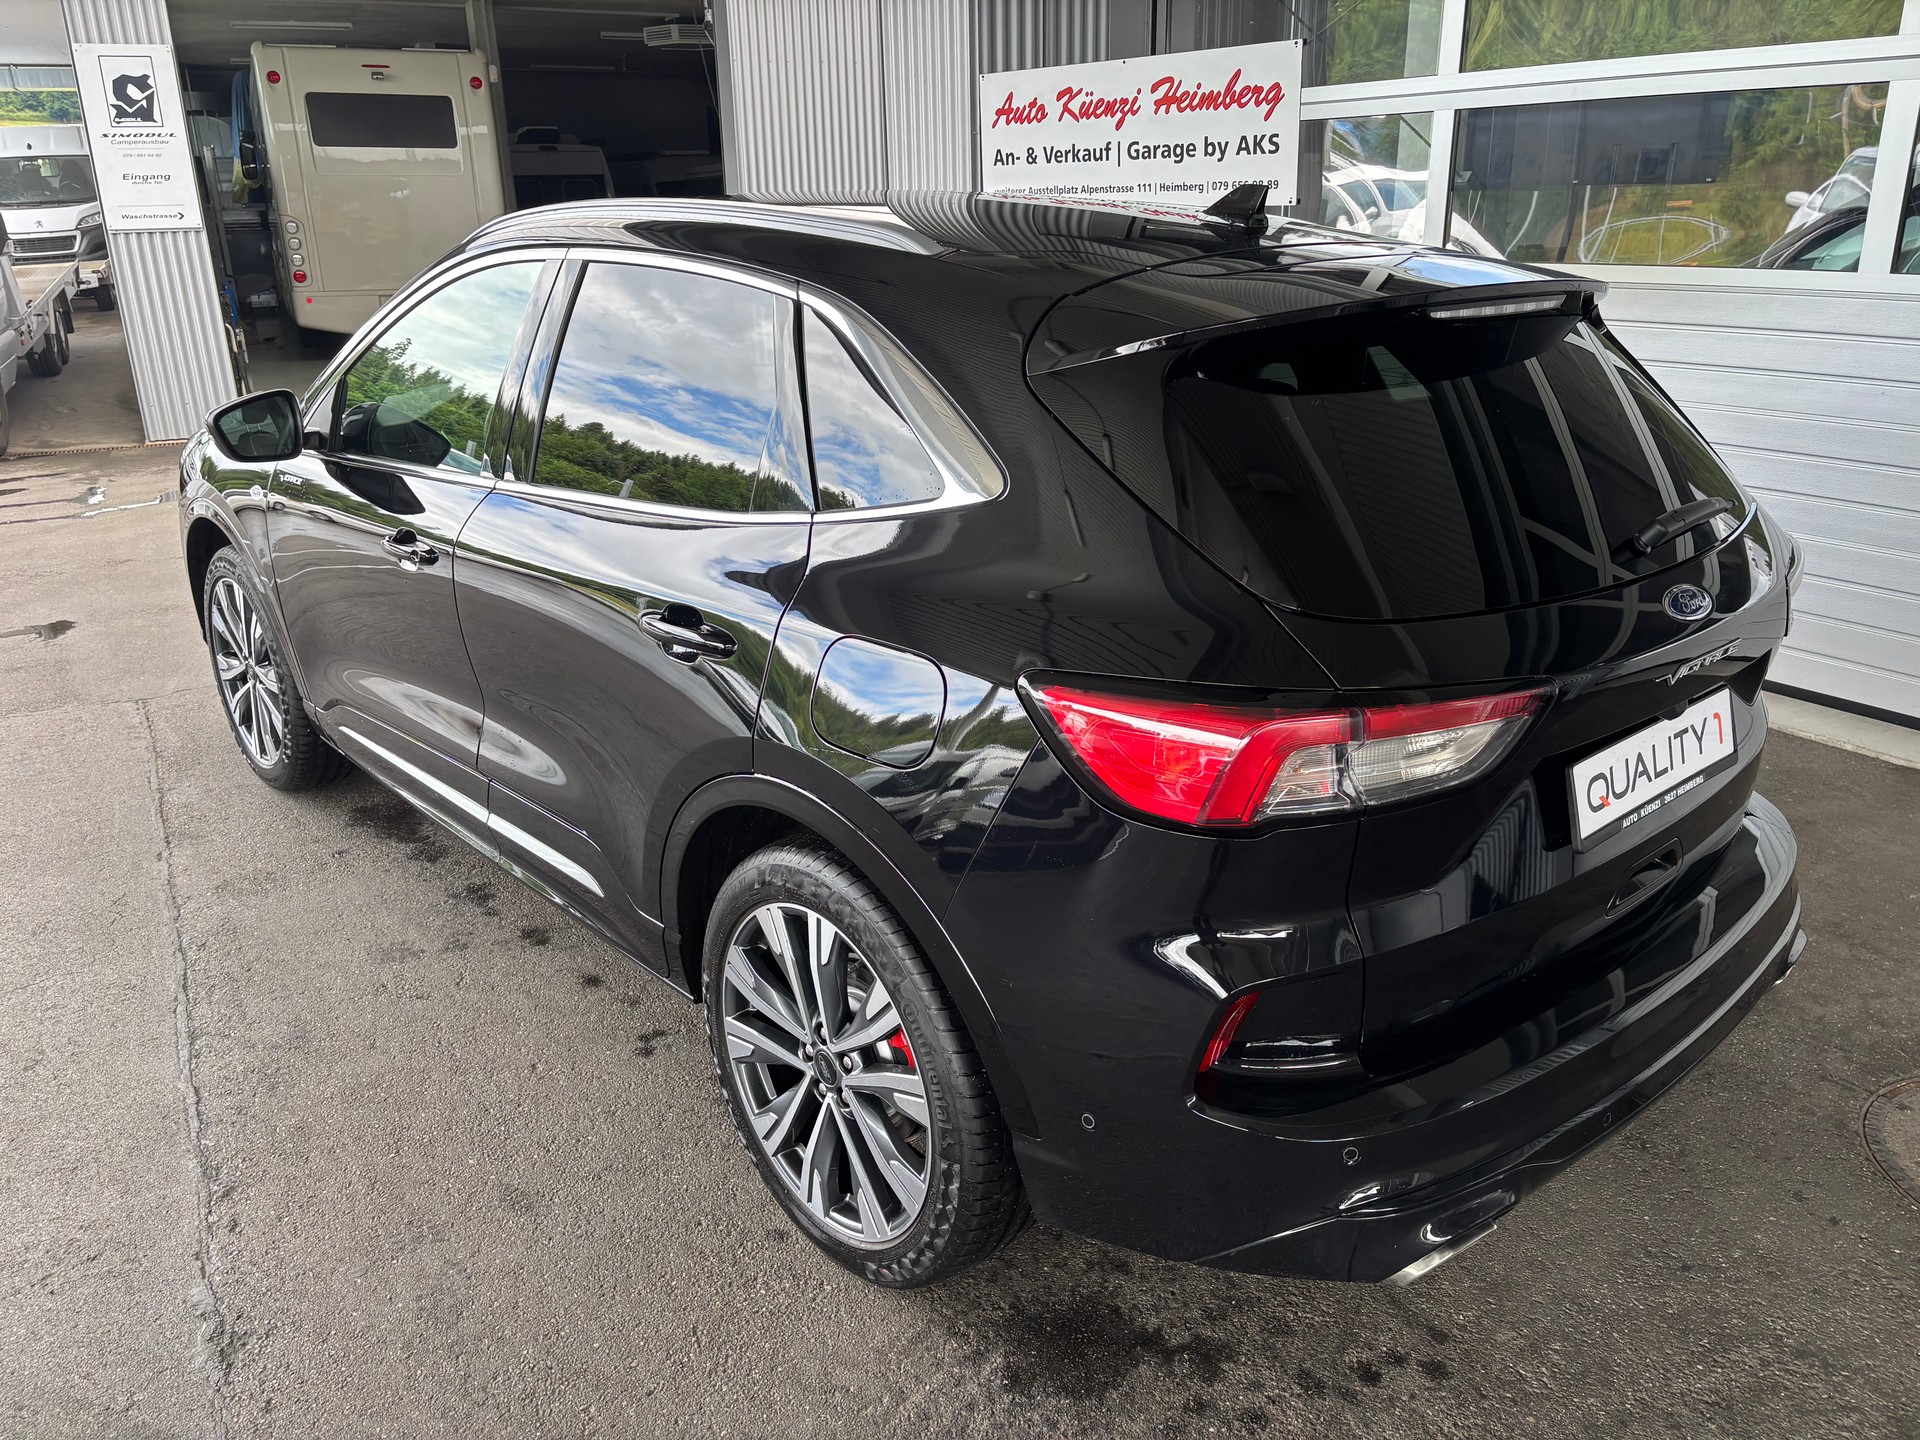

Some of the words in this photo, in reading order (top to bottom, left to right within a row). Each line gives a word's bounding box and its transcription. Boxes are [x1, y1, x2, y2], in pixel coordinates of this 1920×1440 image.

[992, 91, 1048, 129] Auto
[1056, 86, 1142, 131] Küenzi
[1150, 68, 1285, 122] Heimberg
[993, 149, 1020, 166] An-
[1026, 147, 1038, 165] &
[1043, 141, 1112, 164] Verkauf
[1127, 141, 1197, 164] Garage
[1203, 136, 1229, 161] by
[1235, 133, 1280, 156] AKS
[122, 173, 171, 181] Eingang
[1028, 185, 1078, 196] Ausstellplatz
[1081, 184, 1134, 196] Alpenstrasse
[1137, 183, 1152, 193] 111
[1160, 181, 1204, 194] Heimberg
[1212, 180, 1228, 191] 079
[1678, 590, 1708, 613] Ford
[1622, 812, 1638, 828] AUTO
[1677, 774, 1704, 797] HEIMBERG
